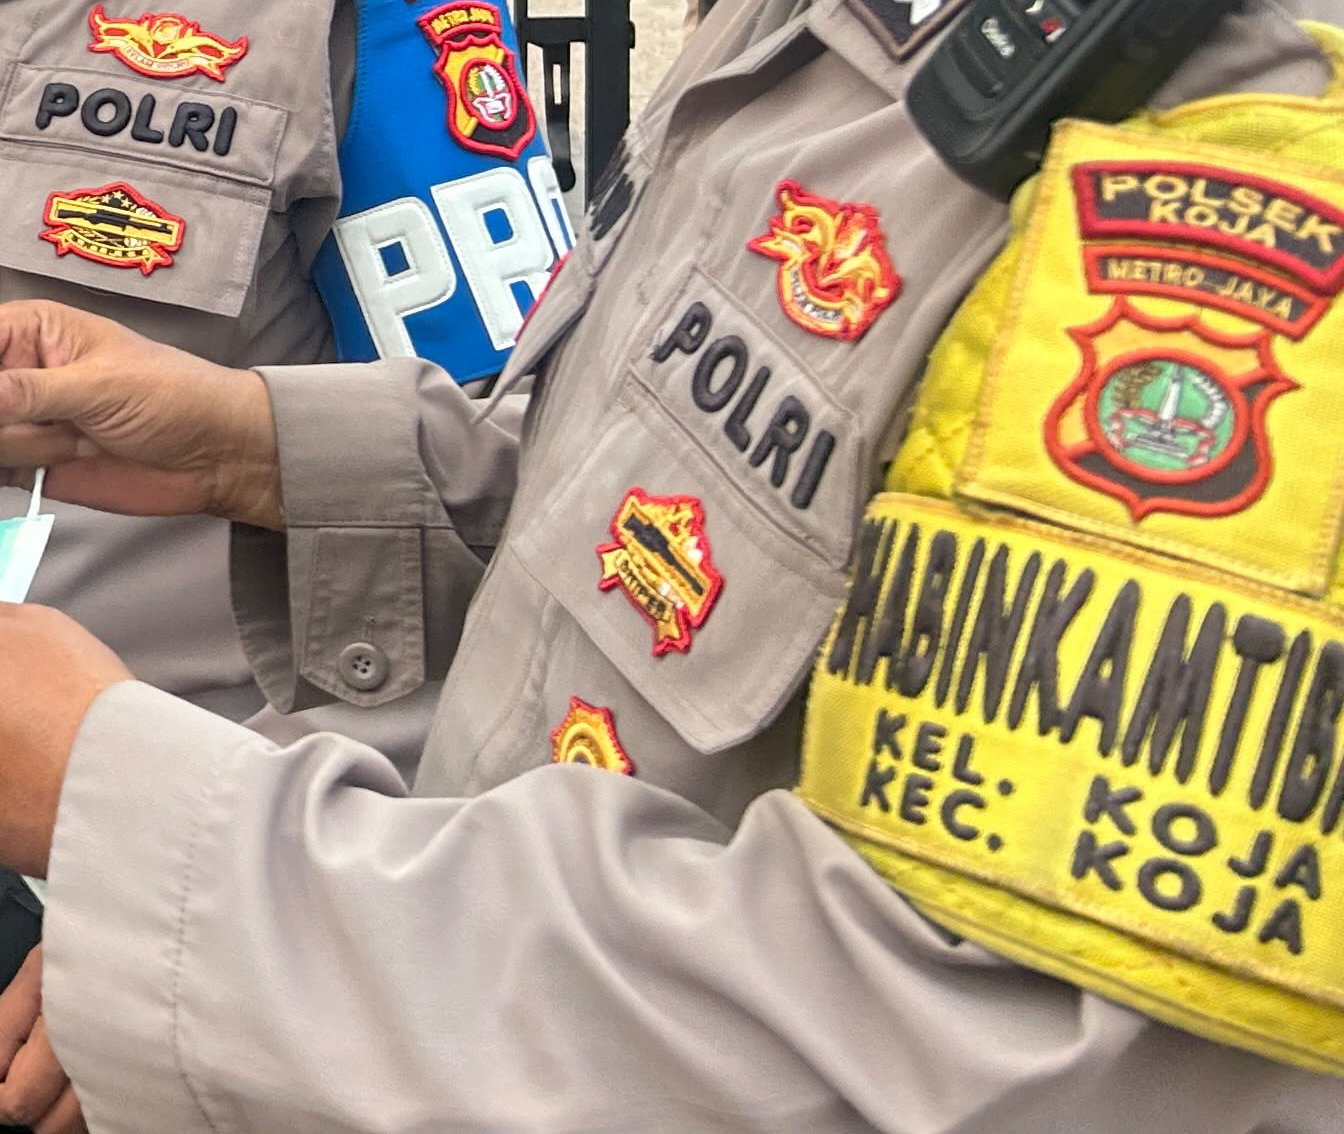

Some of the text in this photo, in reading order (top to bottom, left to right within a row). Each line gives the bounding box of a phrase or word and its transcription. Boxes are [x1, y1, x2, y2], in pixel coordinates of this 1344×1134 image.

[34, 82, 238, 157] POLRI
[1099, 173, 1344, 255] POLSEK
[1148, 198, 1278, 250] KOJA
[1106, 257, 1295, 322] METRO JAYA
[648, 300, 837, 511] POLRI
[827, 514, 1344, 836] HABINKAMTIB
[859, 756, 1306, 957] KEC. KOJA
[1082, 774, 1324, 902] KOJA
